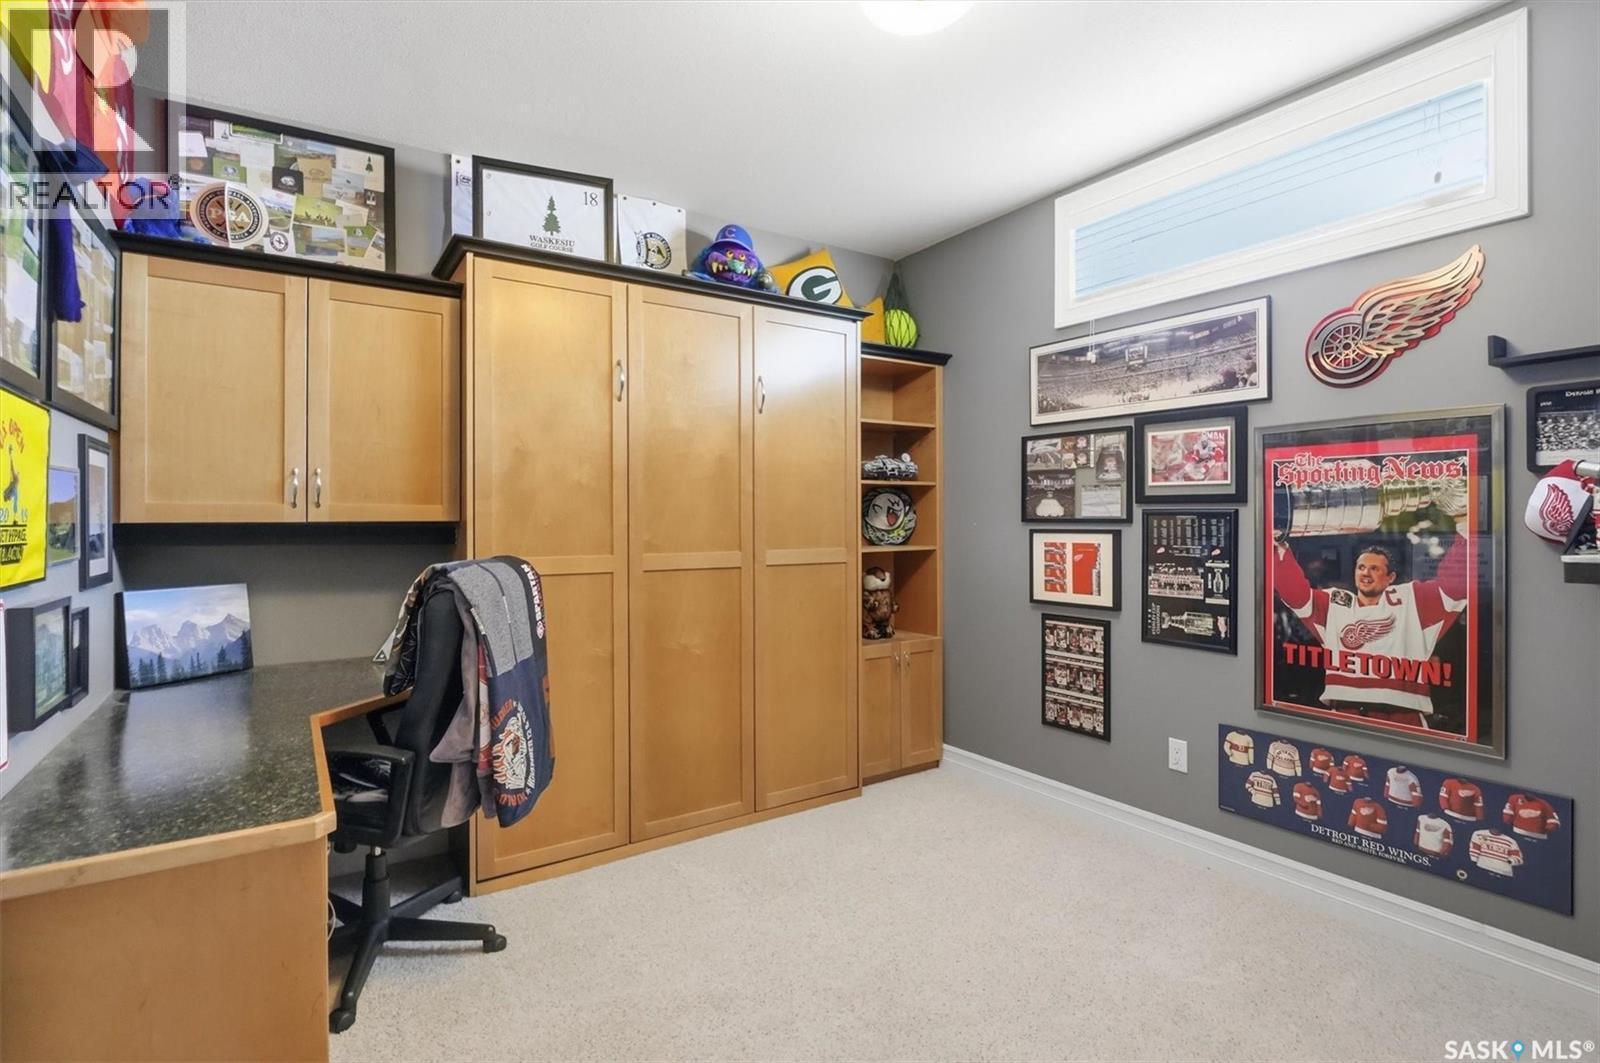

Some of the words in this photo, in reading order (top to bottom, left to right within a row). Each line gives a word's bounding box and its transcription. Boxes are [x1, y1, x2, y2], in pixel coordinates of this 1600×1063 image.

[583, 191, 599, 207] 18
[529, 234, 576, 247] WASKESIU
[1275, 459, 1384, 490] Sporting
[1381, 455, 1464, 481] News
[1294, 452, 1324, 468] The
[520, 563, 542, 621] SPARTAN
[1385, 587, 1403, 607] C
[1283, 641, 1454, 688] TITLETOWN!
[1311, 823, 1360, 845] DETROIT
[1361, 839, 1386, 853] RED
